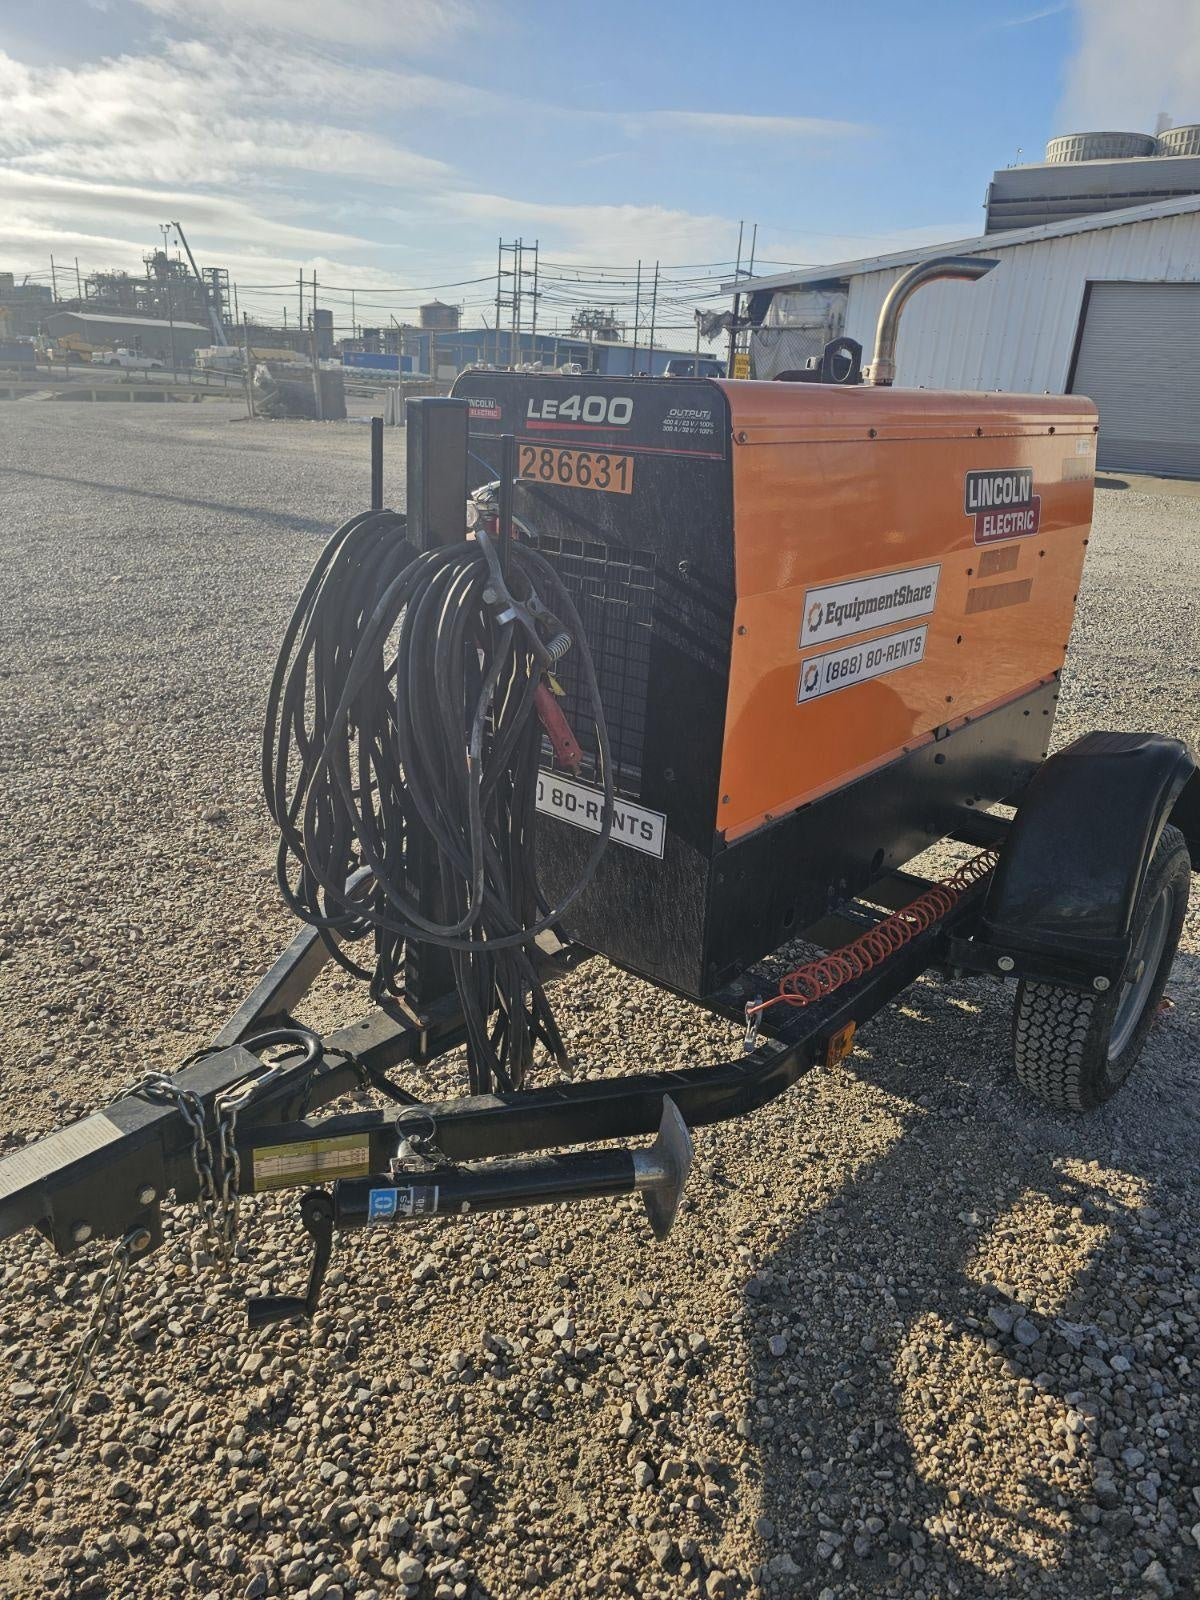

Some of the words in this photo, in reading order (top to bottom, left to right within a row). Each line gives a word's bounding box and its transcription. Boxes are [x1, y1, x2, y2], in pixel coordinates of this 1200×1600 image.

[471, 408, 498, 417] ELECTRIC
[527, 395, 634, 425] LE400
[669, 408, 711, 418] OUTPUT
[522, 446, 628, 491] 286631
[969, 475, 1030, 508] LINCOLN
[982, 510, 1035, 537] ELECTRIC
[824, 583, 932, 627] EquipmentShare
[825, 652, 863, 684] (888)
[865, 635, 922, 669] 80-RENTS
[551, 787, 654, 841] 80-RNTS
